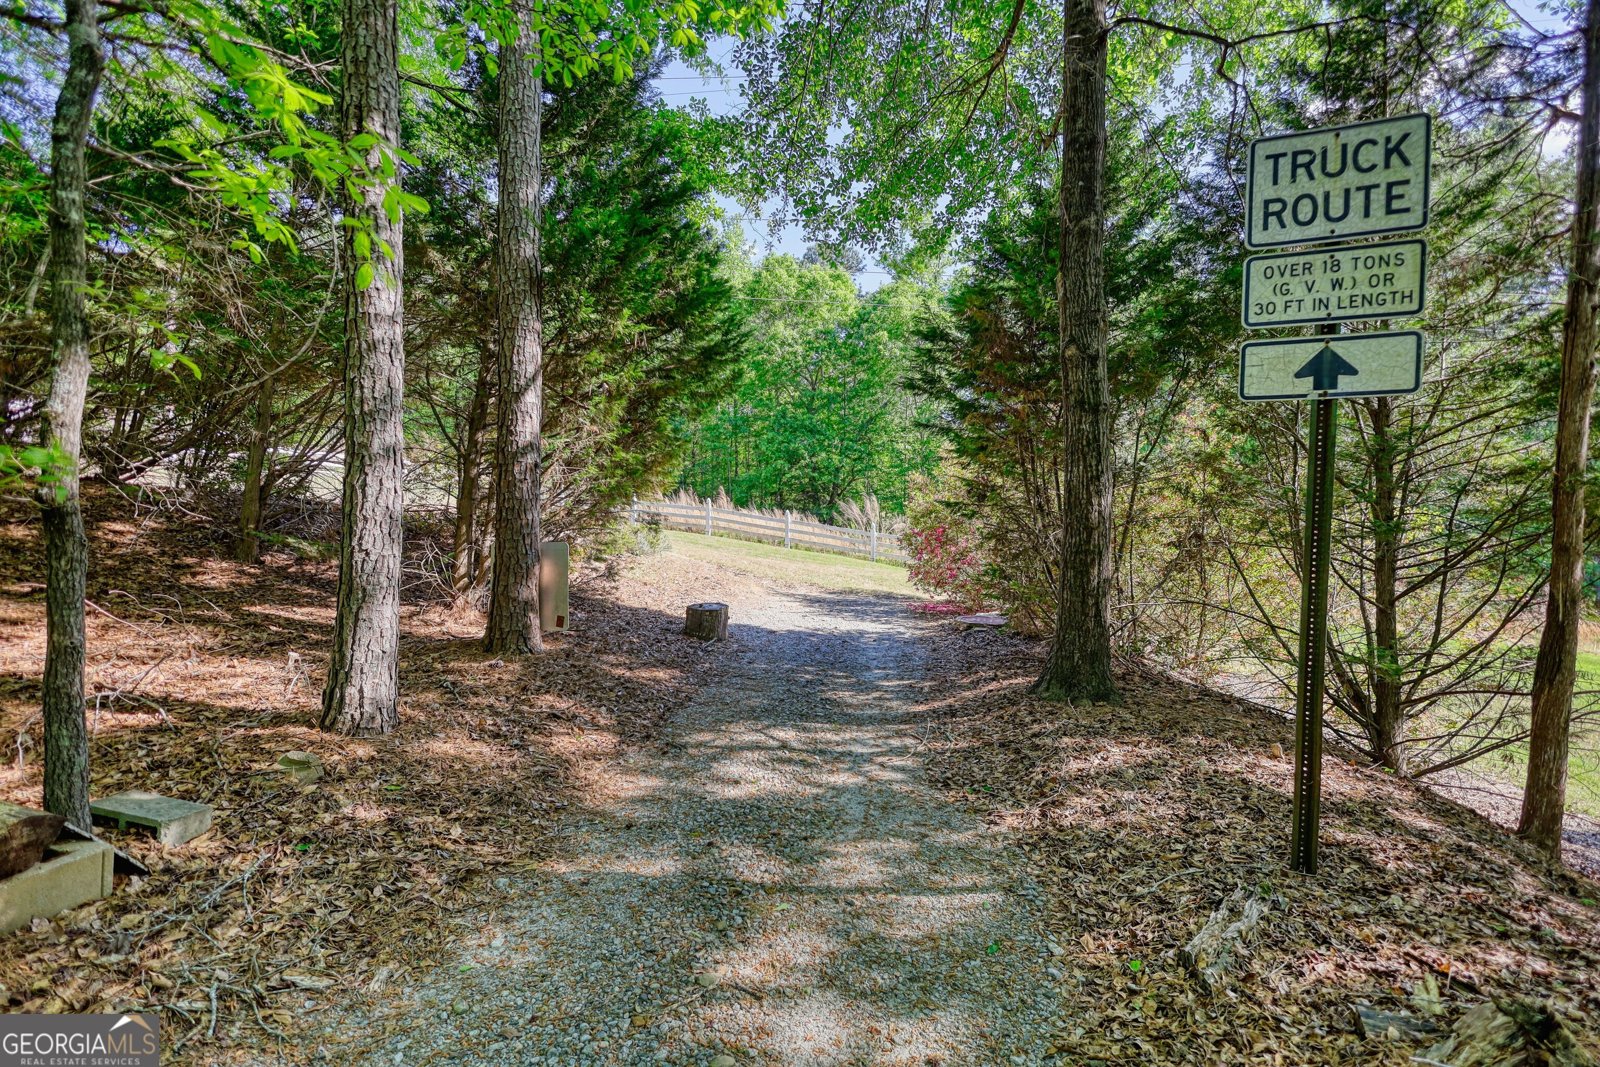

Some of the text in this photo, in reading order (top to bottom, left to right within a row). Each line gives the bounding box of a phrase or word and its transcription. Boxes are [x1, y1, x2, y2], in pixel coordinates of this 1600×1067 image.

[1265, 132, 1412, 186] TRUCK
[1262, 179, 1411, 231] ROUTE
[1263, 252, 1405, 280] OVER 18 TONS
[1369, 273, 1395, 288] OR
[1254, 290, 1414, 316] 30 FT IN LENGTH
